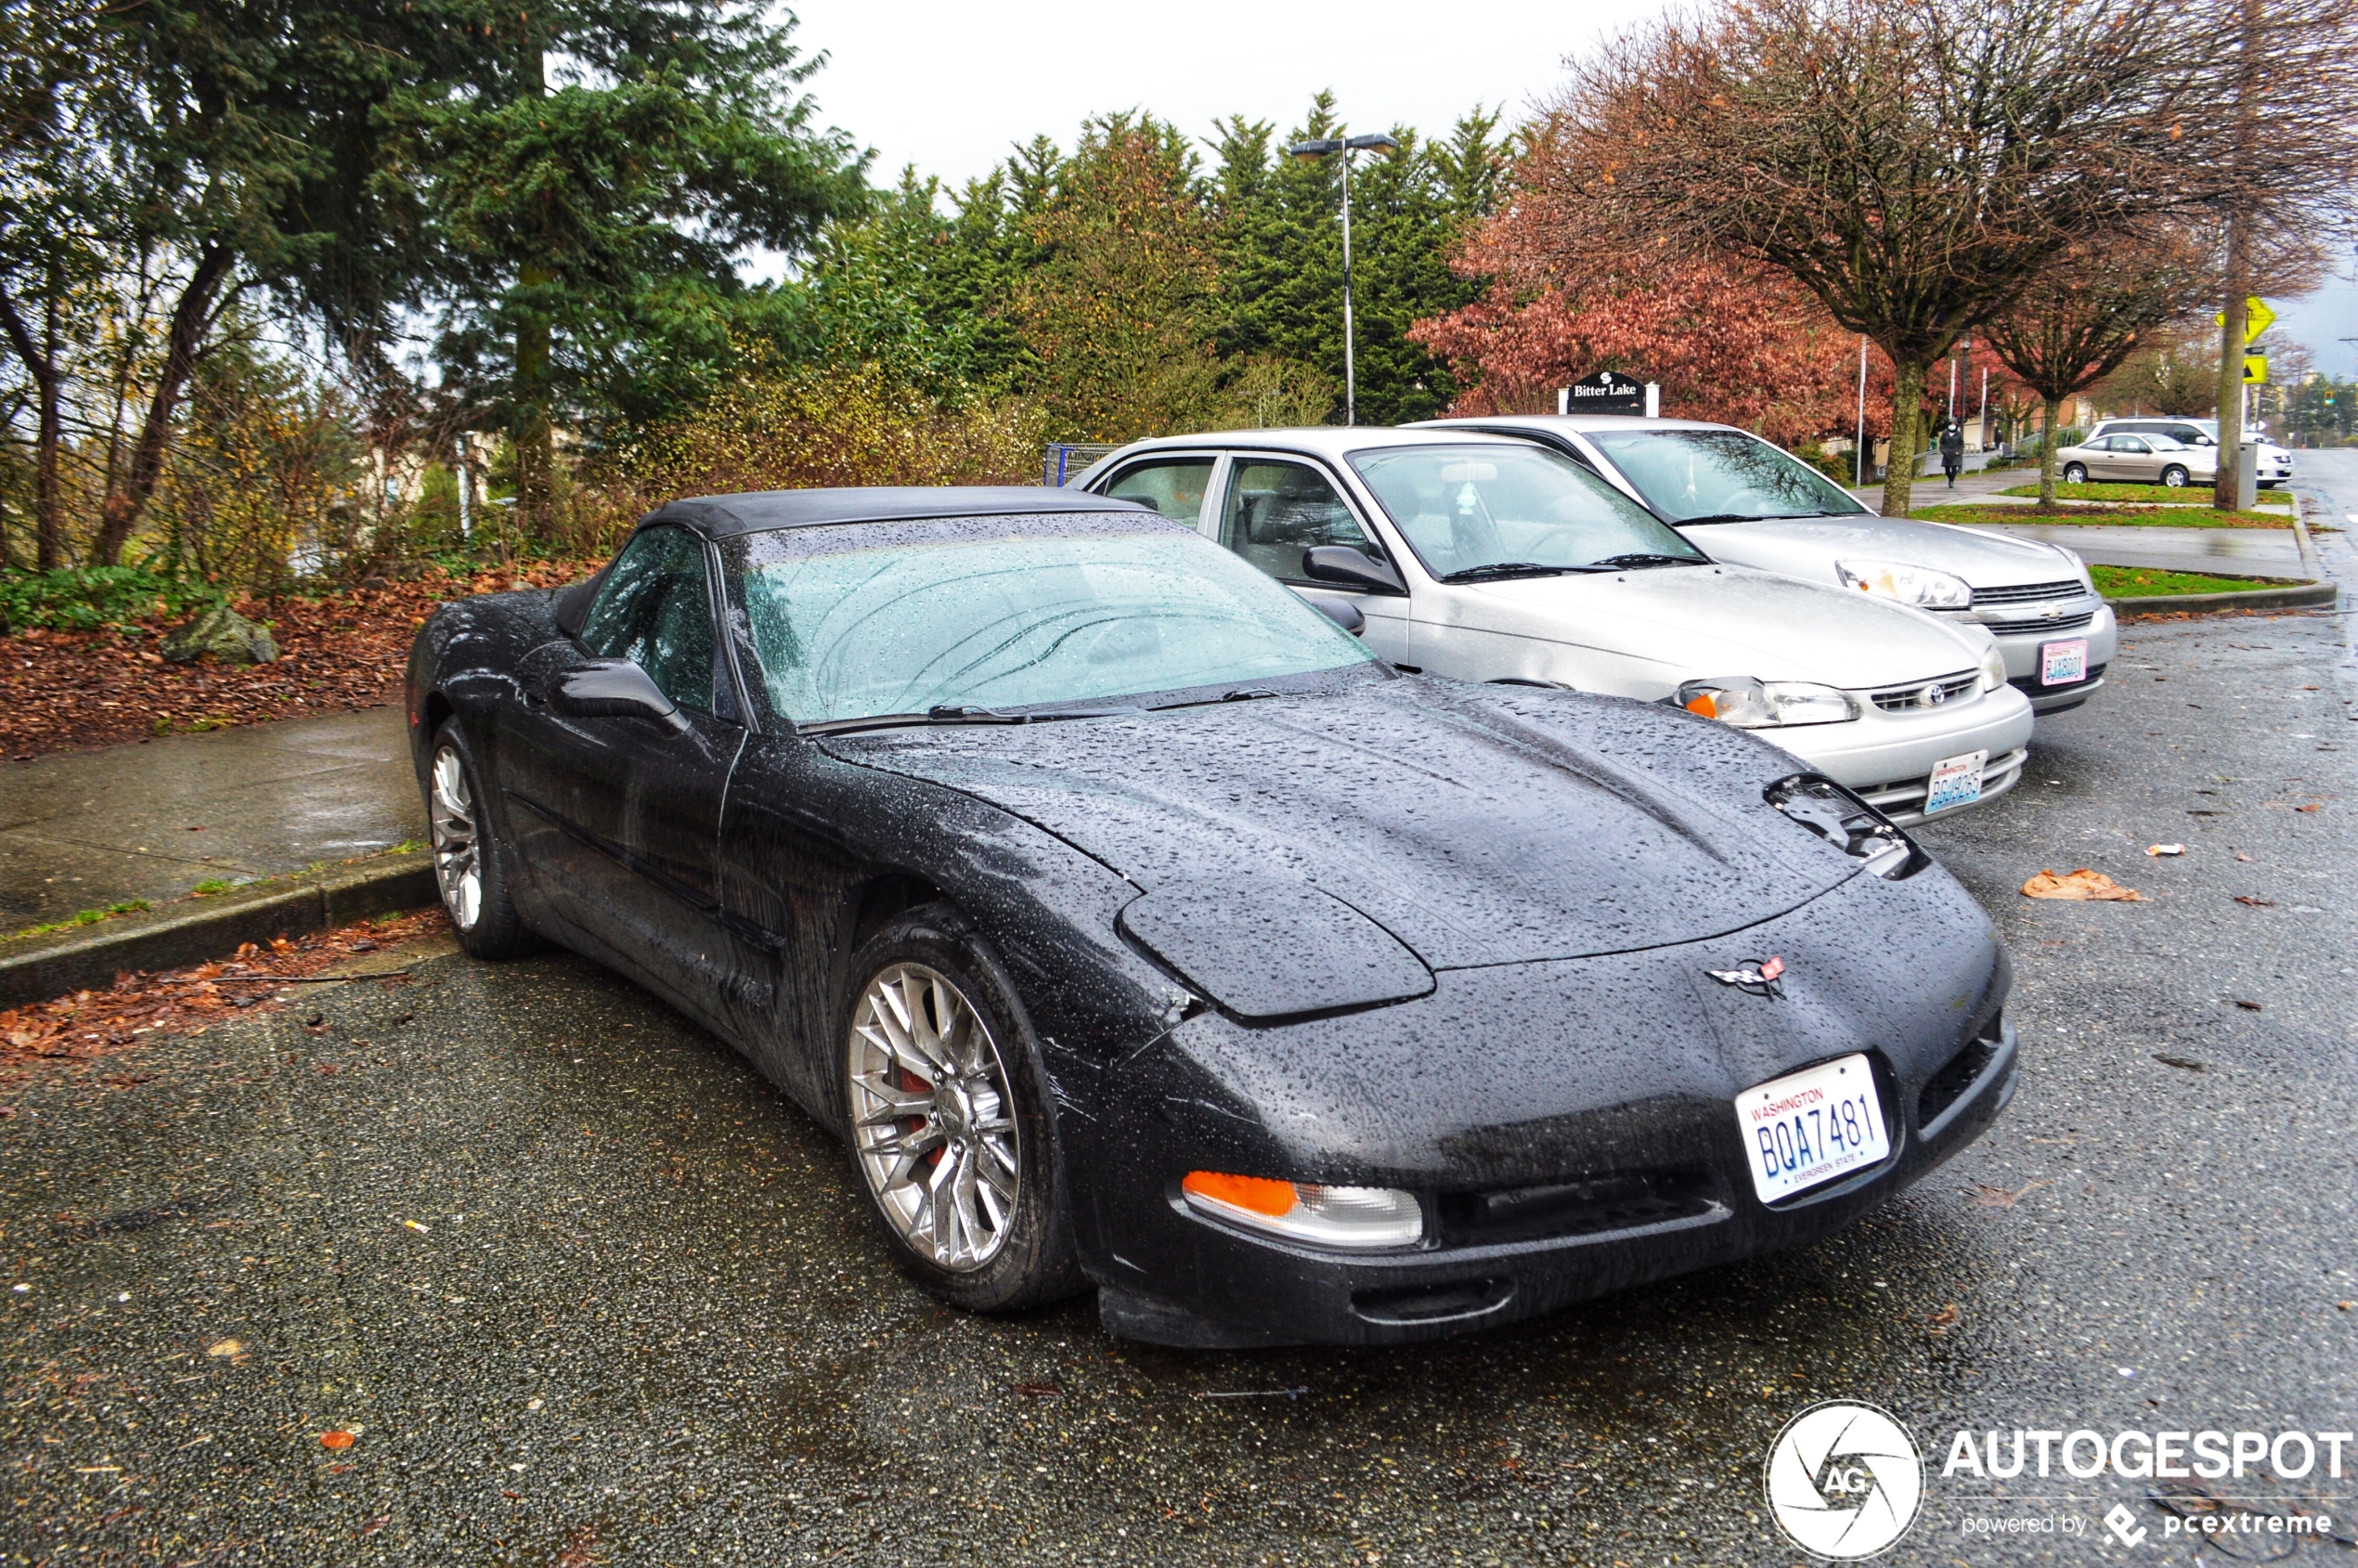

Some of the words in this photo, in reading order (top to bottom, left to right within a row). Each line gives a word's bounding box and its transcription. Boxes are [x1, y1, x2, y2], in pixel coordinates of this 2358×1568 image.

[1574, 385, 1607, 396] Bitter
[1609, 383, 1637, 395] Lake
[1936, 764, 1967, 776] WASHINGTON
[1931, 769, 1980, 806] BGJ9265
[1751, 1087, 1824, 1122] WASHINGTON
[1757, 1094, 1875, 1179] BQA7481
[1794, 1163, 1833, 1184] EVERGREEN
[1835, 1153, 1856, 1167] STATE
